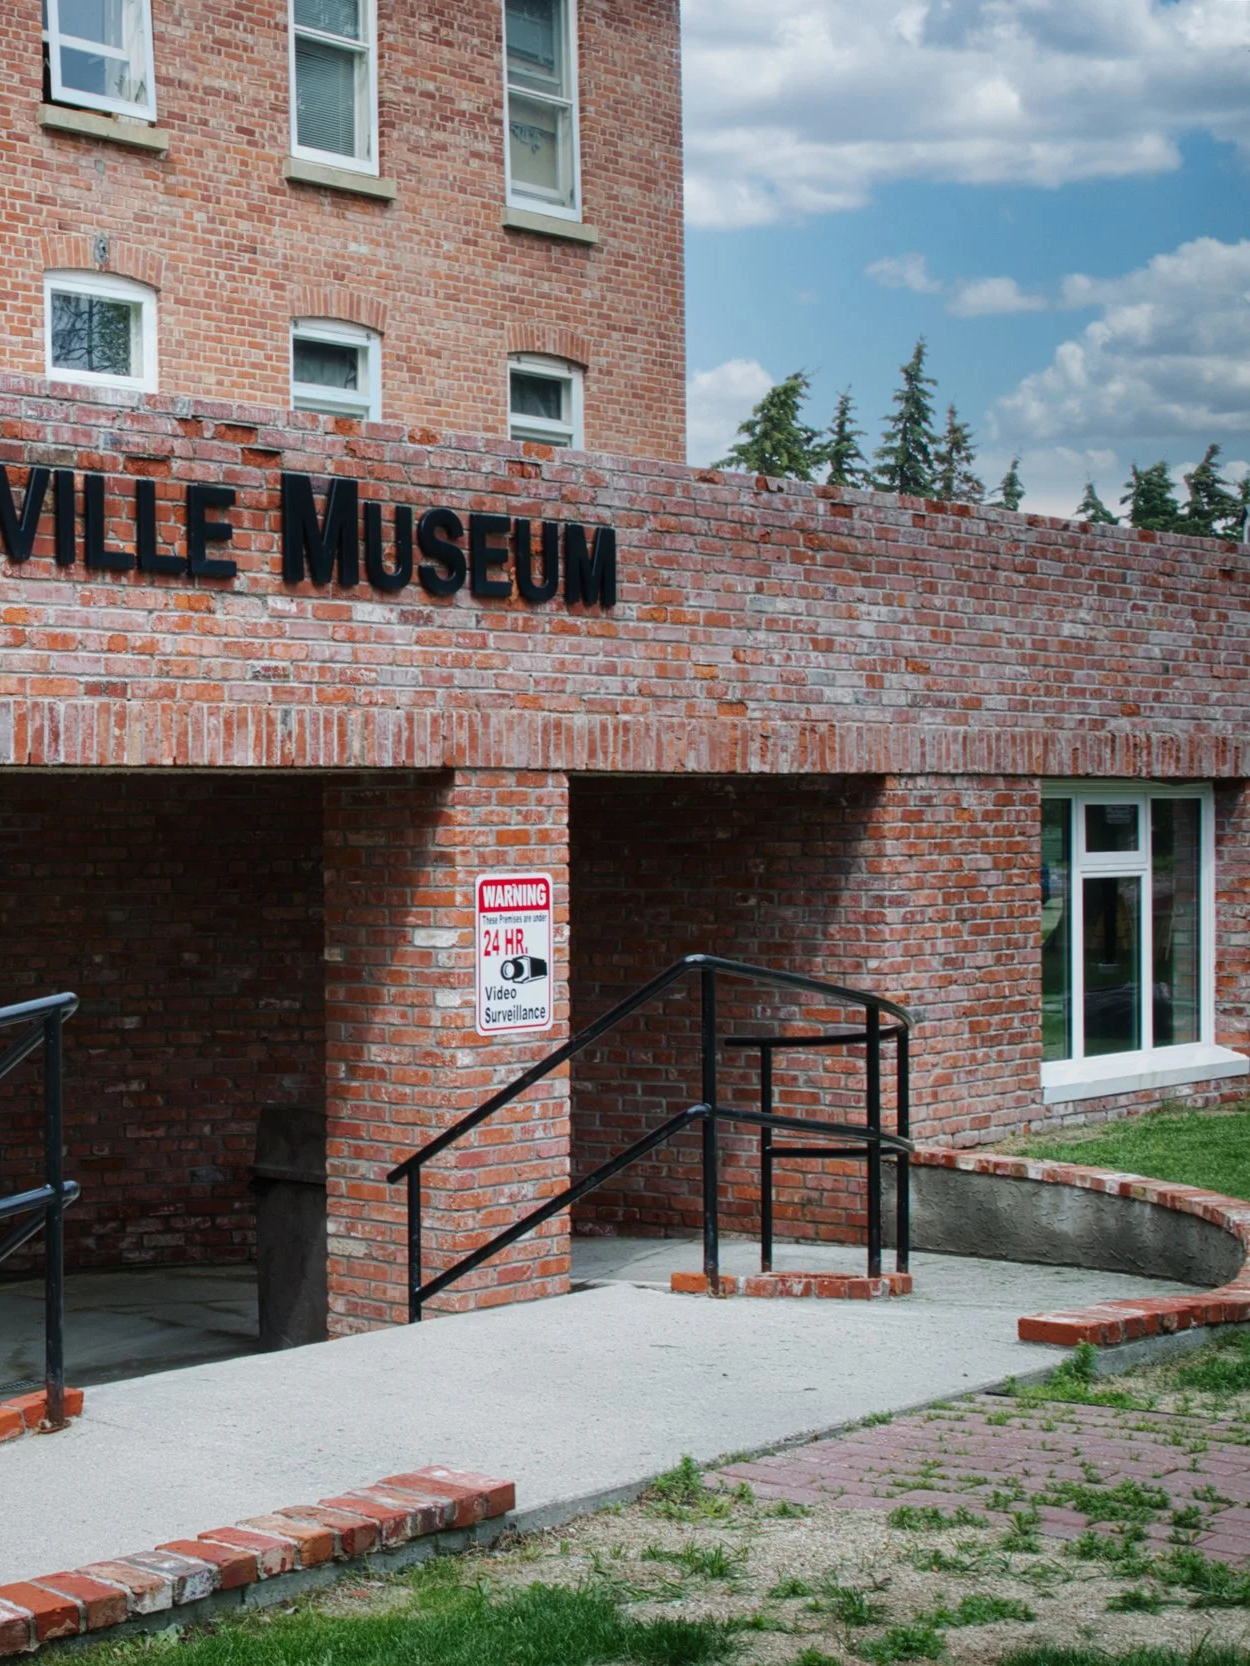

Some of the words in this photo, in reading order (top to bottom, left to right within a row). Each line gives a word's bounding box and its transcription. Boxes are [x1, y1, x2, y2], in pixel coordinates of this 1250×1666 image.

[280, 473, 616, 610] MUSEUM
[482, 883, 547, 908] WARNING
[482, 914, 498, 925] These
[499, 913, 522, 923] Premises
[523, 914, 532, 923] are
[533, 911, 547, 922] under
[483, 929, 500, 957] 24
[505, 928, 528, 956] HR.
[485, 985, 517, 1001] Video
[485, 1004, 546, 1024] Surveillance
